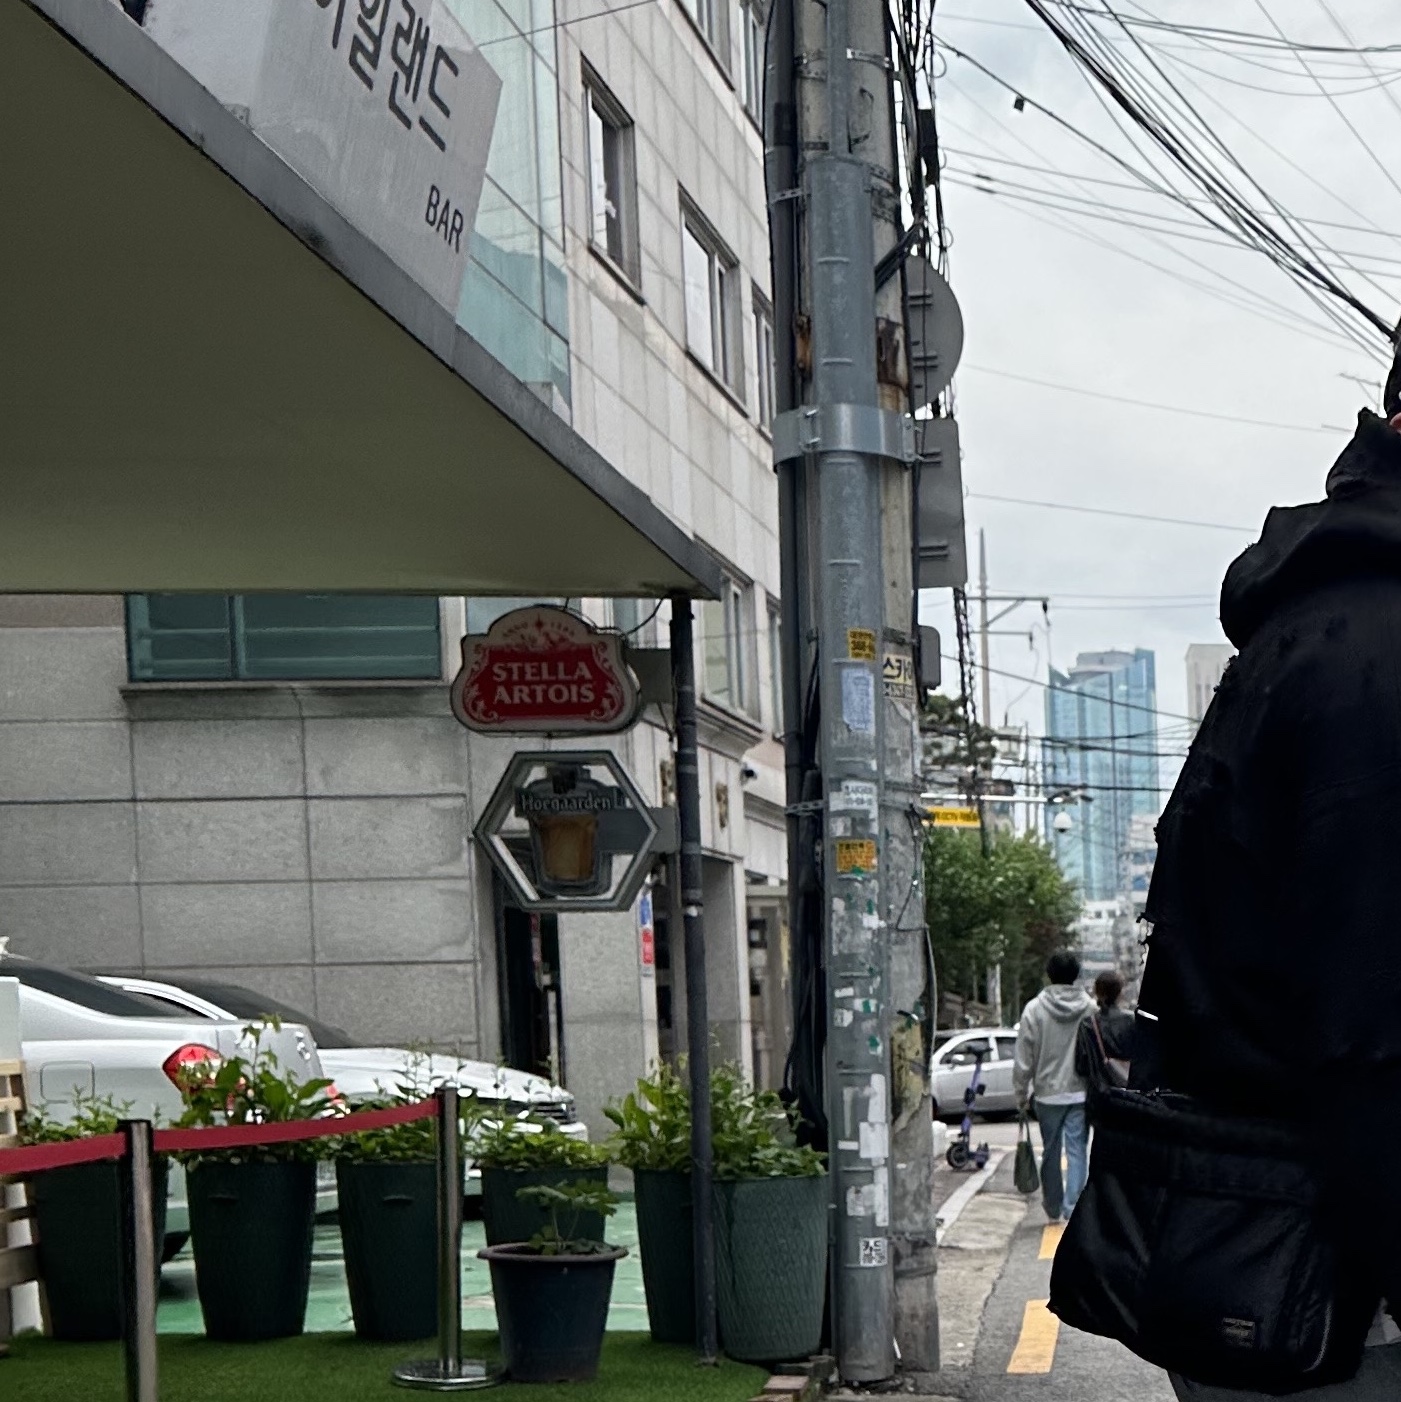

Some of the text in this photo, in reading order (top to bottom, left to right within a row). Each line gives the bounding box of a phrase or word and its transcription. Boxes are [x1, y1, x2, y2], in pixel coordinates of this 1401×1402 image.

[425, 185, 464, 253] BAR
[492, 661, 593, 682] STELLA
[492, 683, 596, 706] ARTOIS
[521, 790, 612, 812] Hoegaarden
